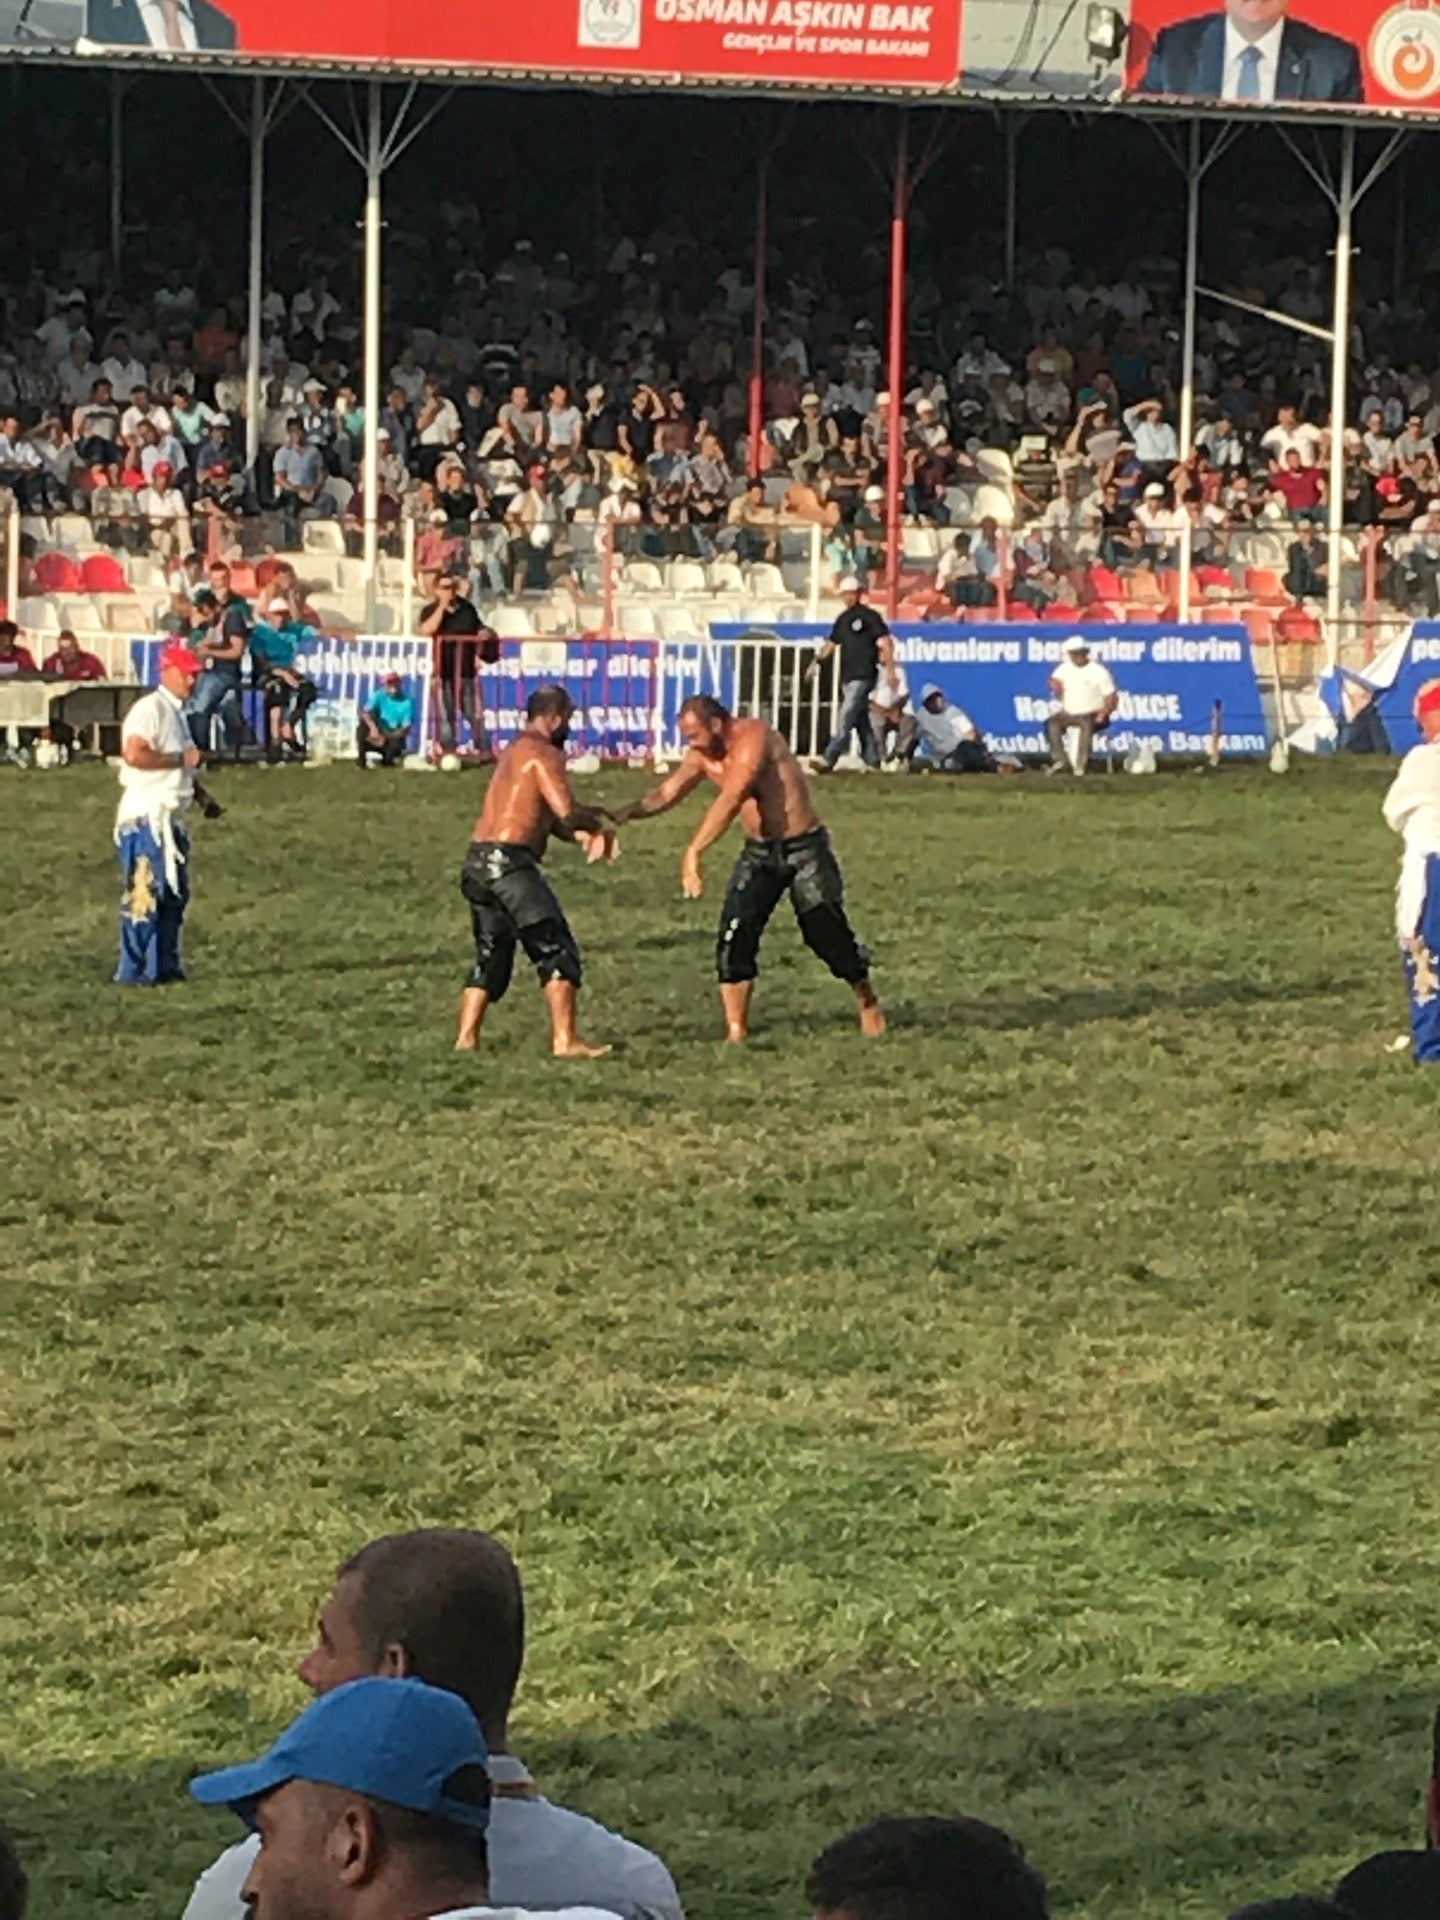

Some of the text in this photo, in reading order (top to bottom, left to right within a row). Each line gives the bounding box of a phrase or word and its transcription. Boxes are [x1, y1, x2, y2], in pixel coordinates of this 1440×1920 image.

[655, 0, 933, 35] OSMAN AŞKIN BAK
[796, 35, 816, 53] VE
[818, 37, 863, 55] SPOR
[1151, 636, 1242, 663] dilerim
